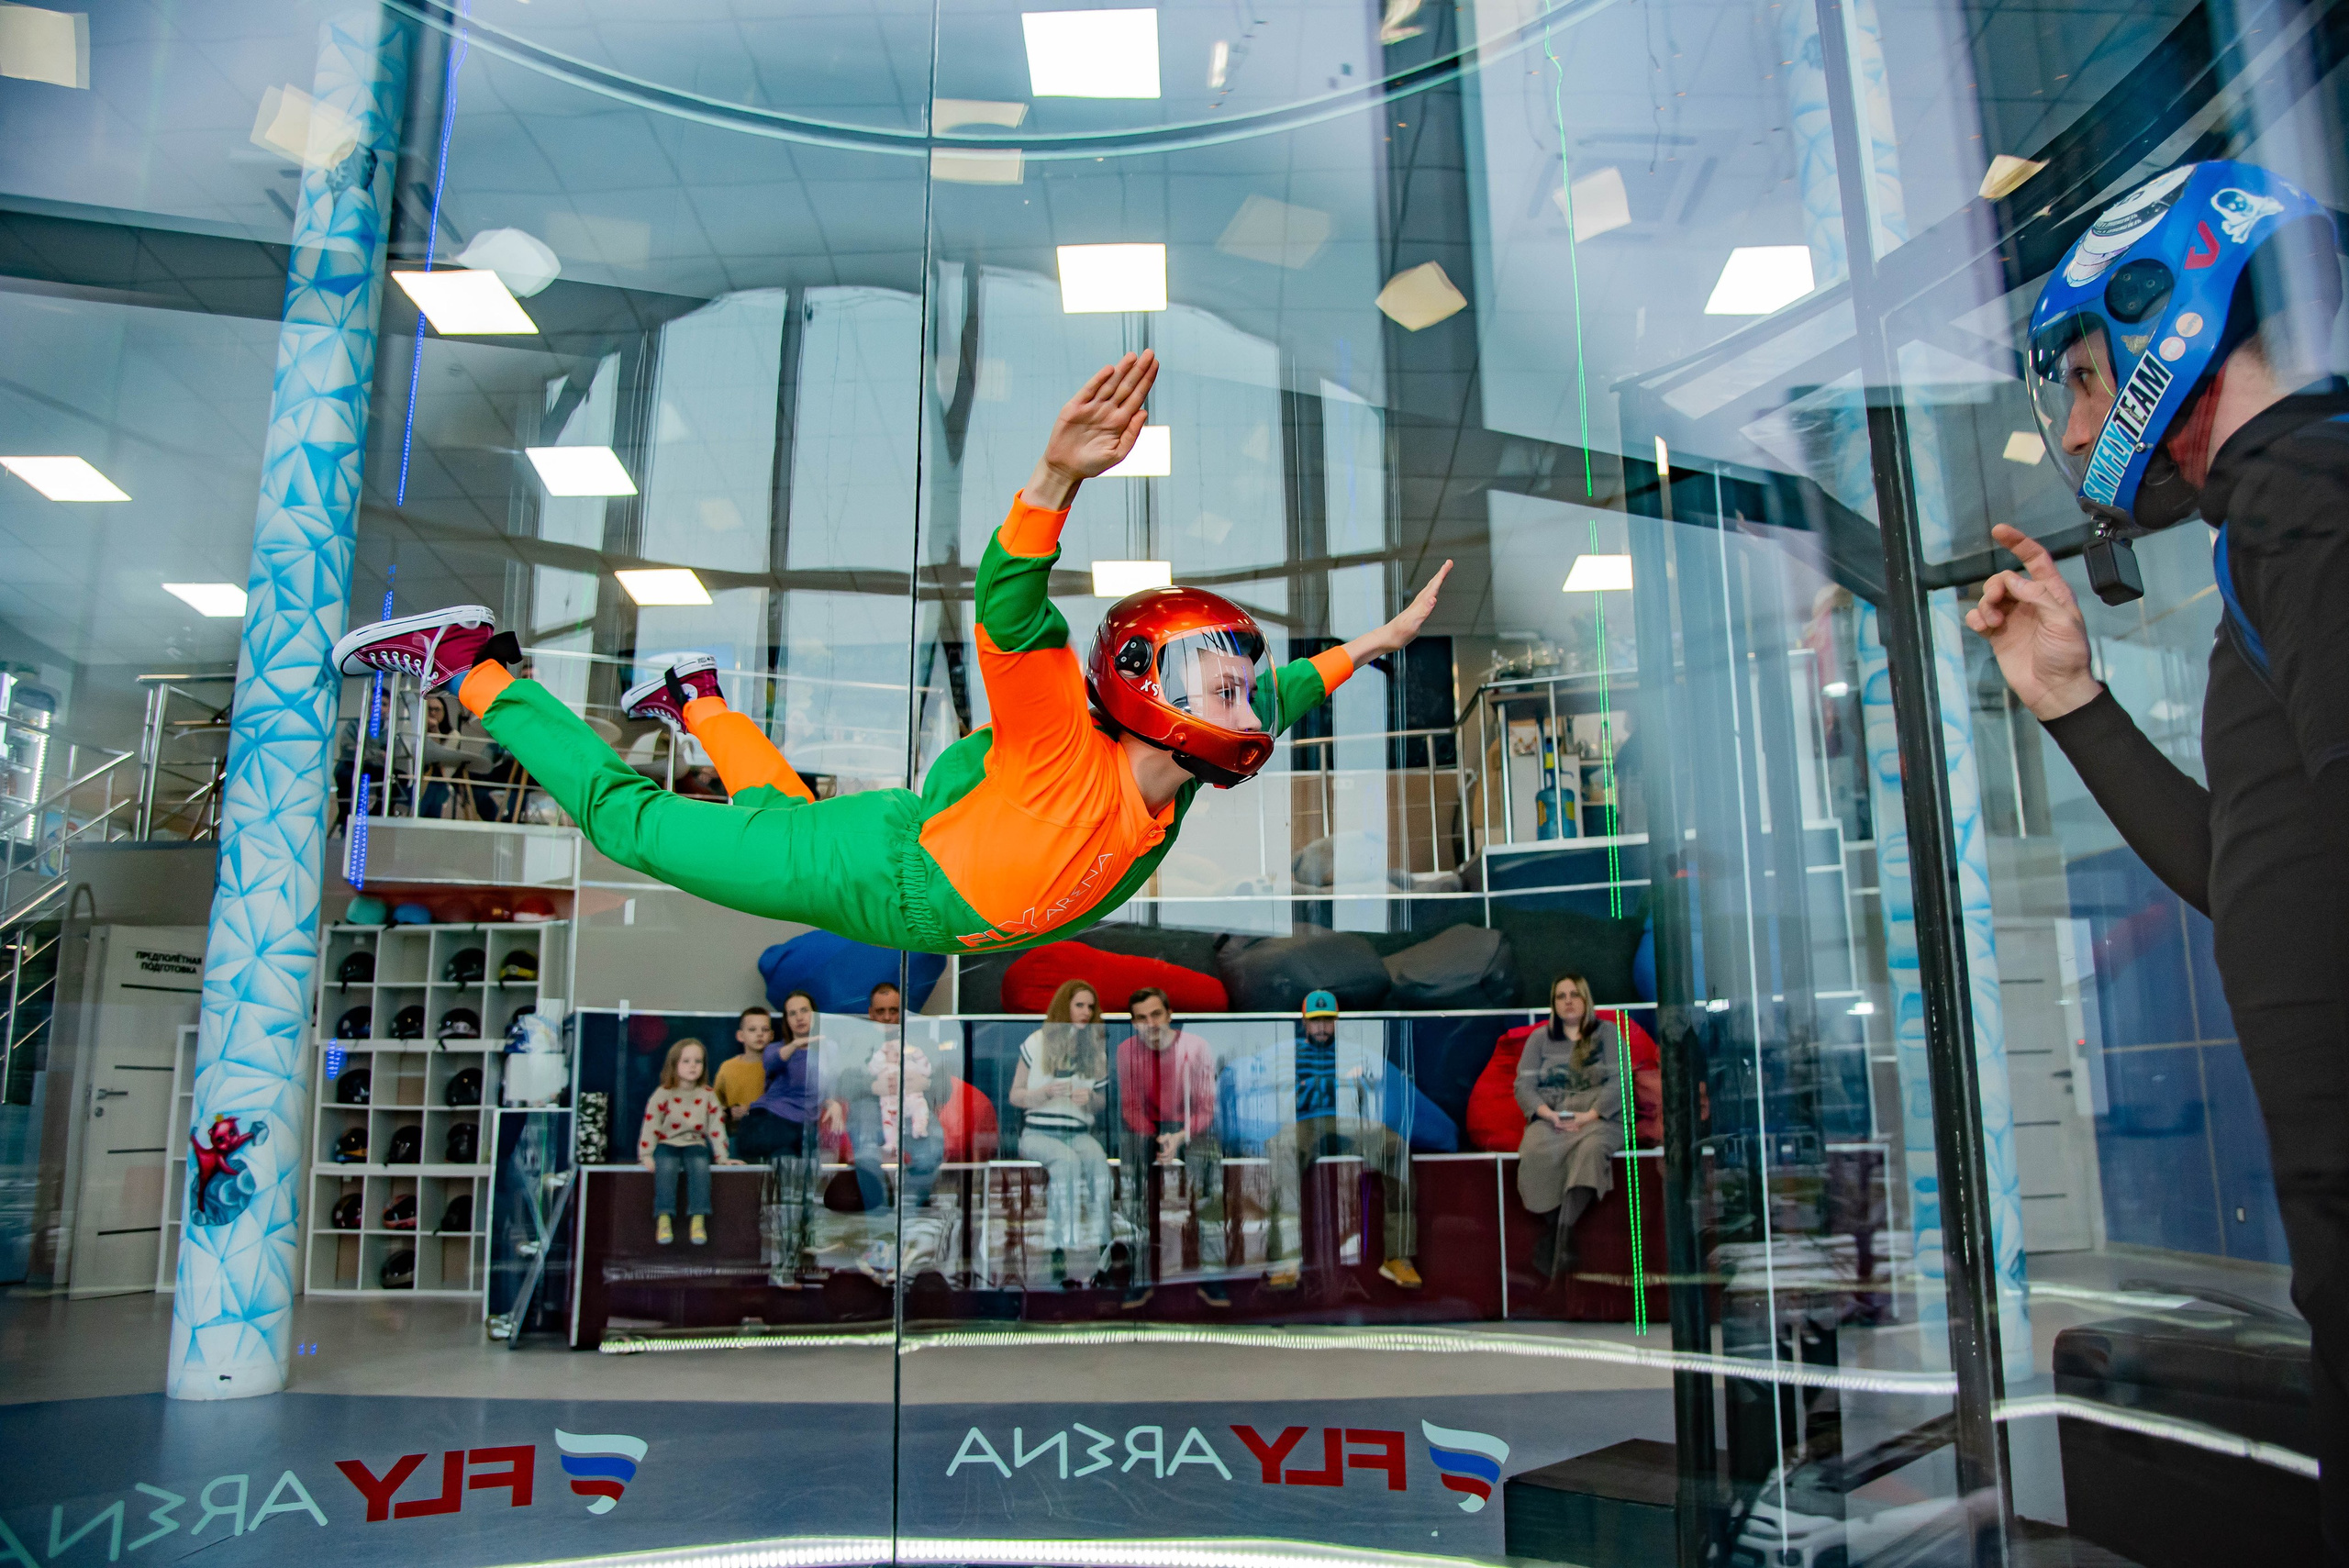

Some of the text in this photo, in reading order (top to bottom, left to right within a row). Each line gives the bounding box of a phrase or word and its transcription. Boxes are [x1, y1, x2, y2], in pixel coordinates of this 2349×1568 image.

[1140, 679, 1160, 696] XS
[956, 852, 1114, 948] FLY ARENA
[140, 962, 197, 974] ПОДГОТОВКА
